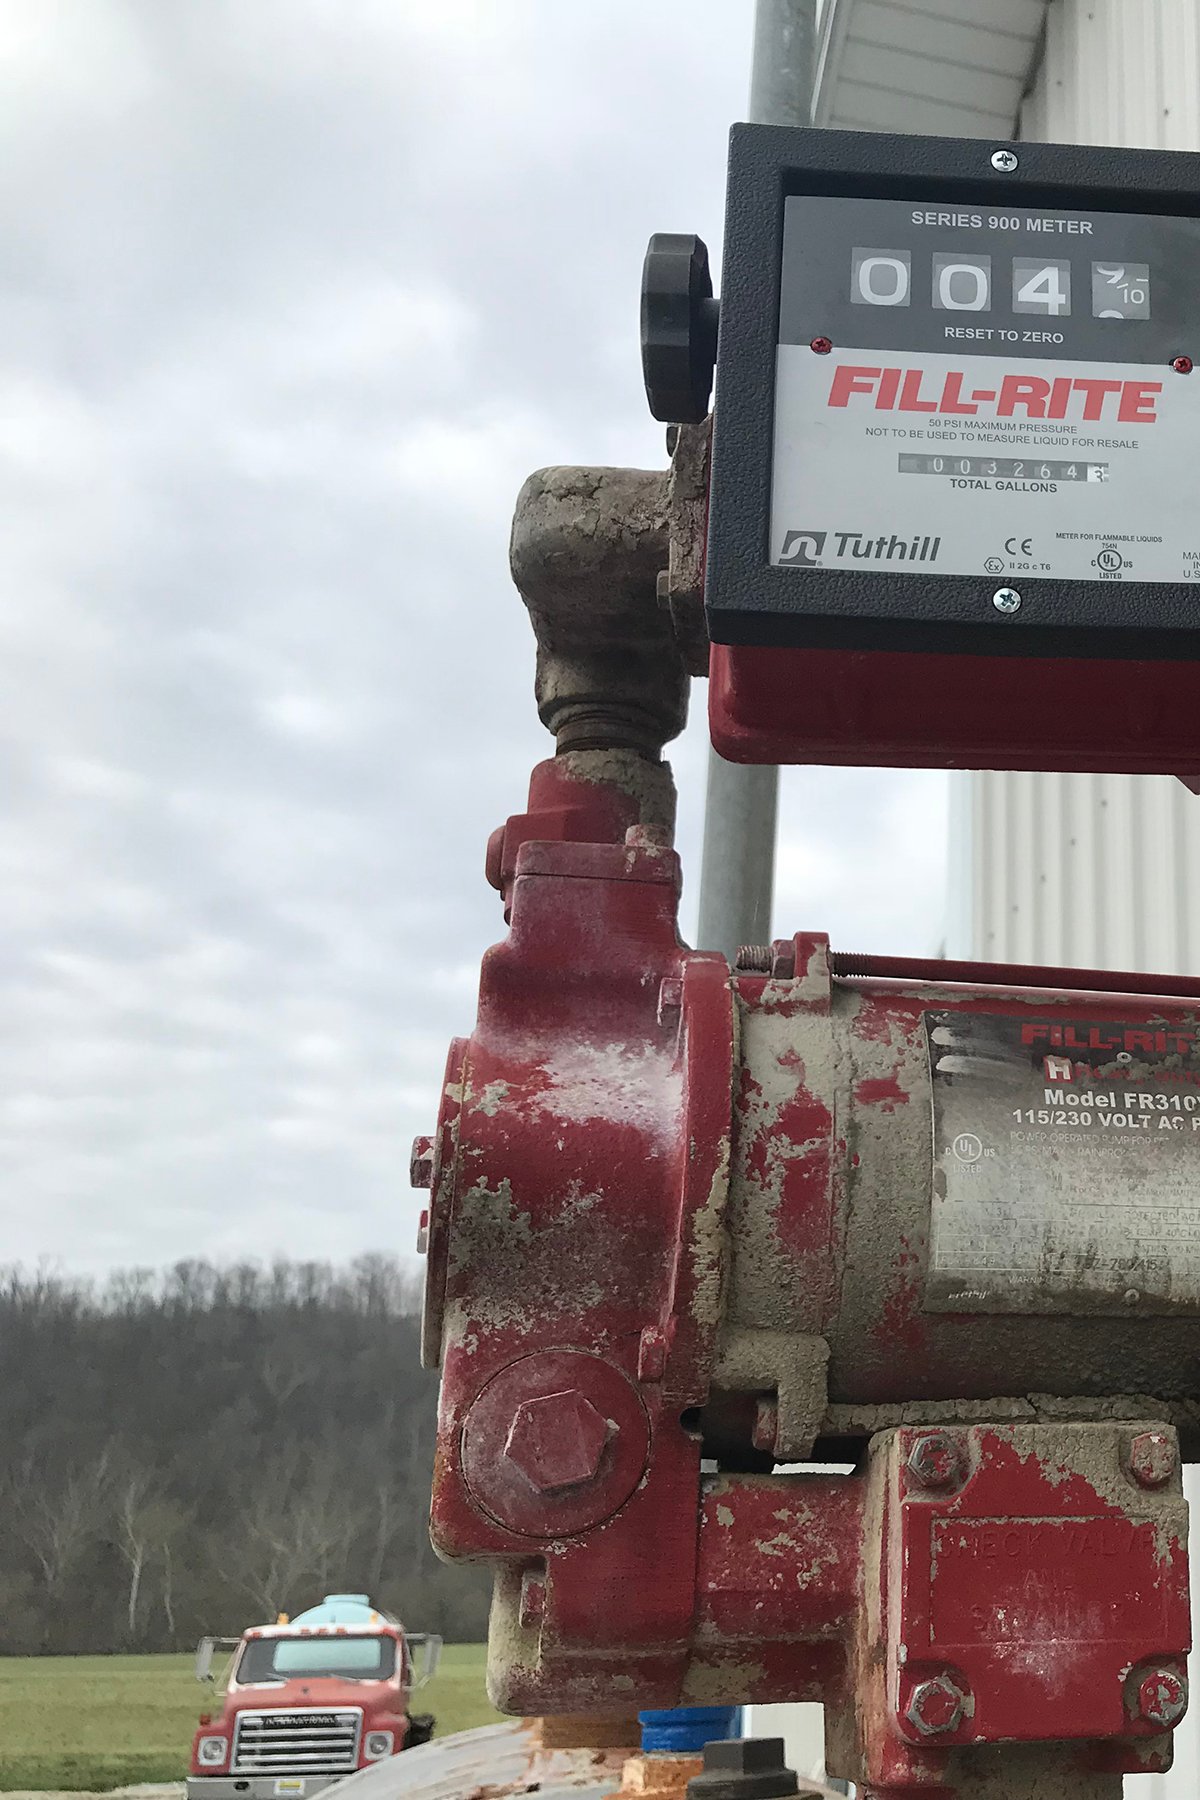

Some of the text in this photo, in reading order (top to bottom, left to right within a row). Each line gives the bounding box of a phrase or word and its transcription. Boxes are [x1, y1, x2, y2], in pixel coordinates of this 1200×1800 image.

[911, 211, 1094, 235] SERIES 900 METER
[944, 326, 1064, 344] RESET TO ZERO
[827, 365, 1163, 424] FILL-RITE
[928, 418, 1078, 434] 50 PSI MAXIMUM PRESSURE
[865, 427, 1140, 449] NOT TO BE USED TO MEASURE LIQUID FOR RESALE
[950, 478, 1058, 493] TOTAL GALLONS
[834, 532, 941, 561] Tuthill
[1056, 532, 1163, 543] METER FOR FLAMMABLE LIQUIDS
[1017, 562, 1030, 570] 2G
[1039, 563, 1051, 571] T6
[1123, 560, 1133, 568] US
[1099, 572, 1122, 580] LISTED
[1020, 1023, 1197, 1054] FILL-RIT
[1044, 1088, 1116, 1108] Model
[1012, 1108, 1092, 1126] 115/230
[1097, 1112, 1152, 1128] VOLT
[1158, 1115, 1185, 1130] AC
[959, 1139, 976, 1157] UL
[983, 1148, 996, 1158] US
[1131, 1136, 1151, 1146] FOR
[953, 1163, 982, 1174] LISTED
